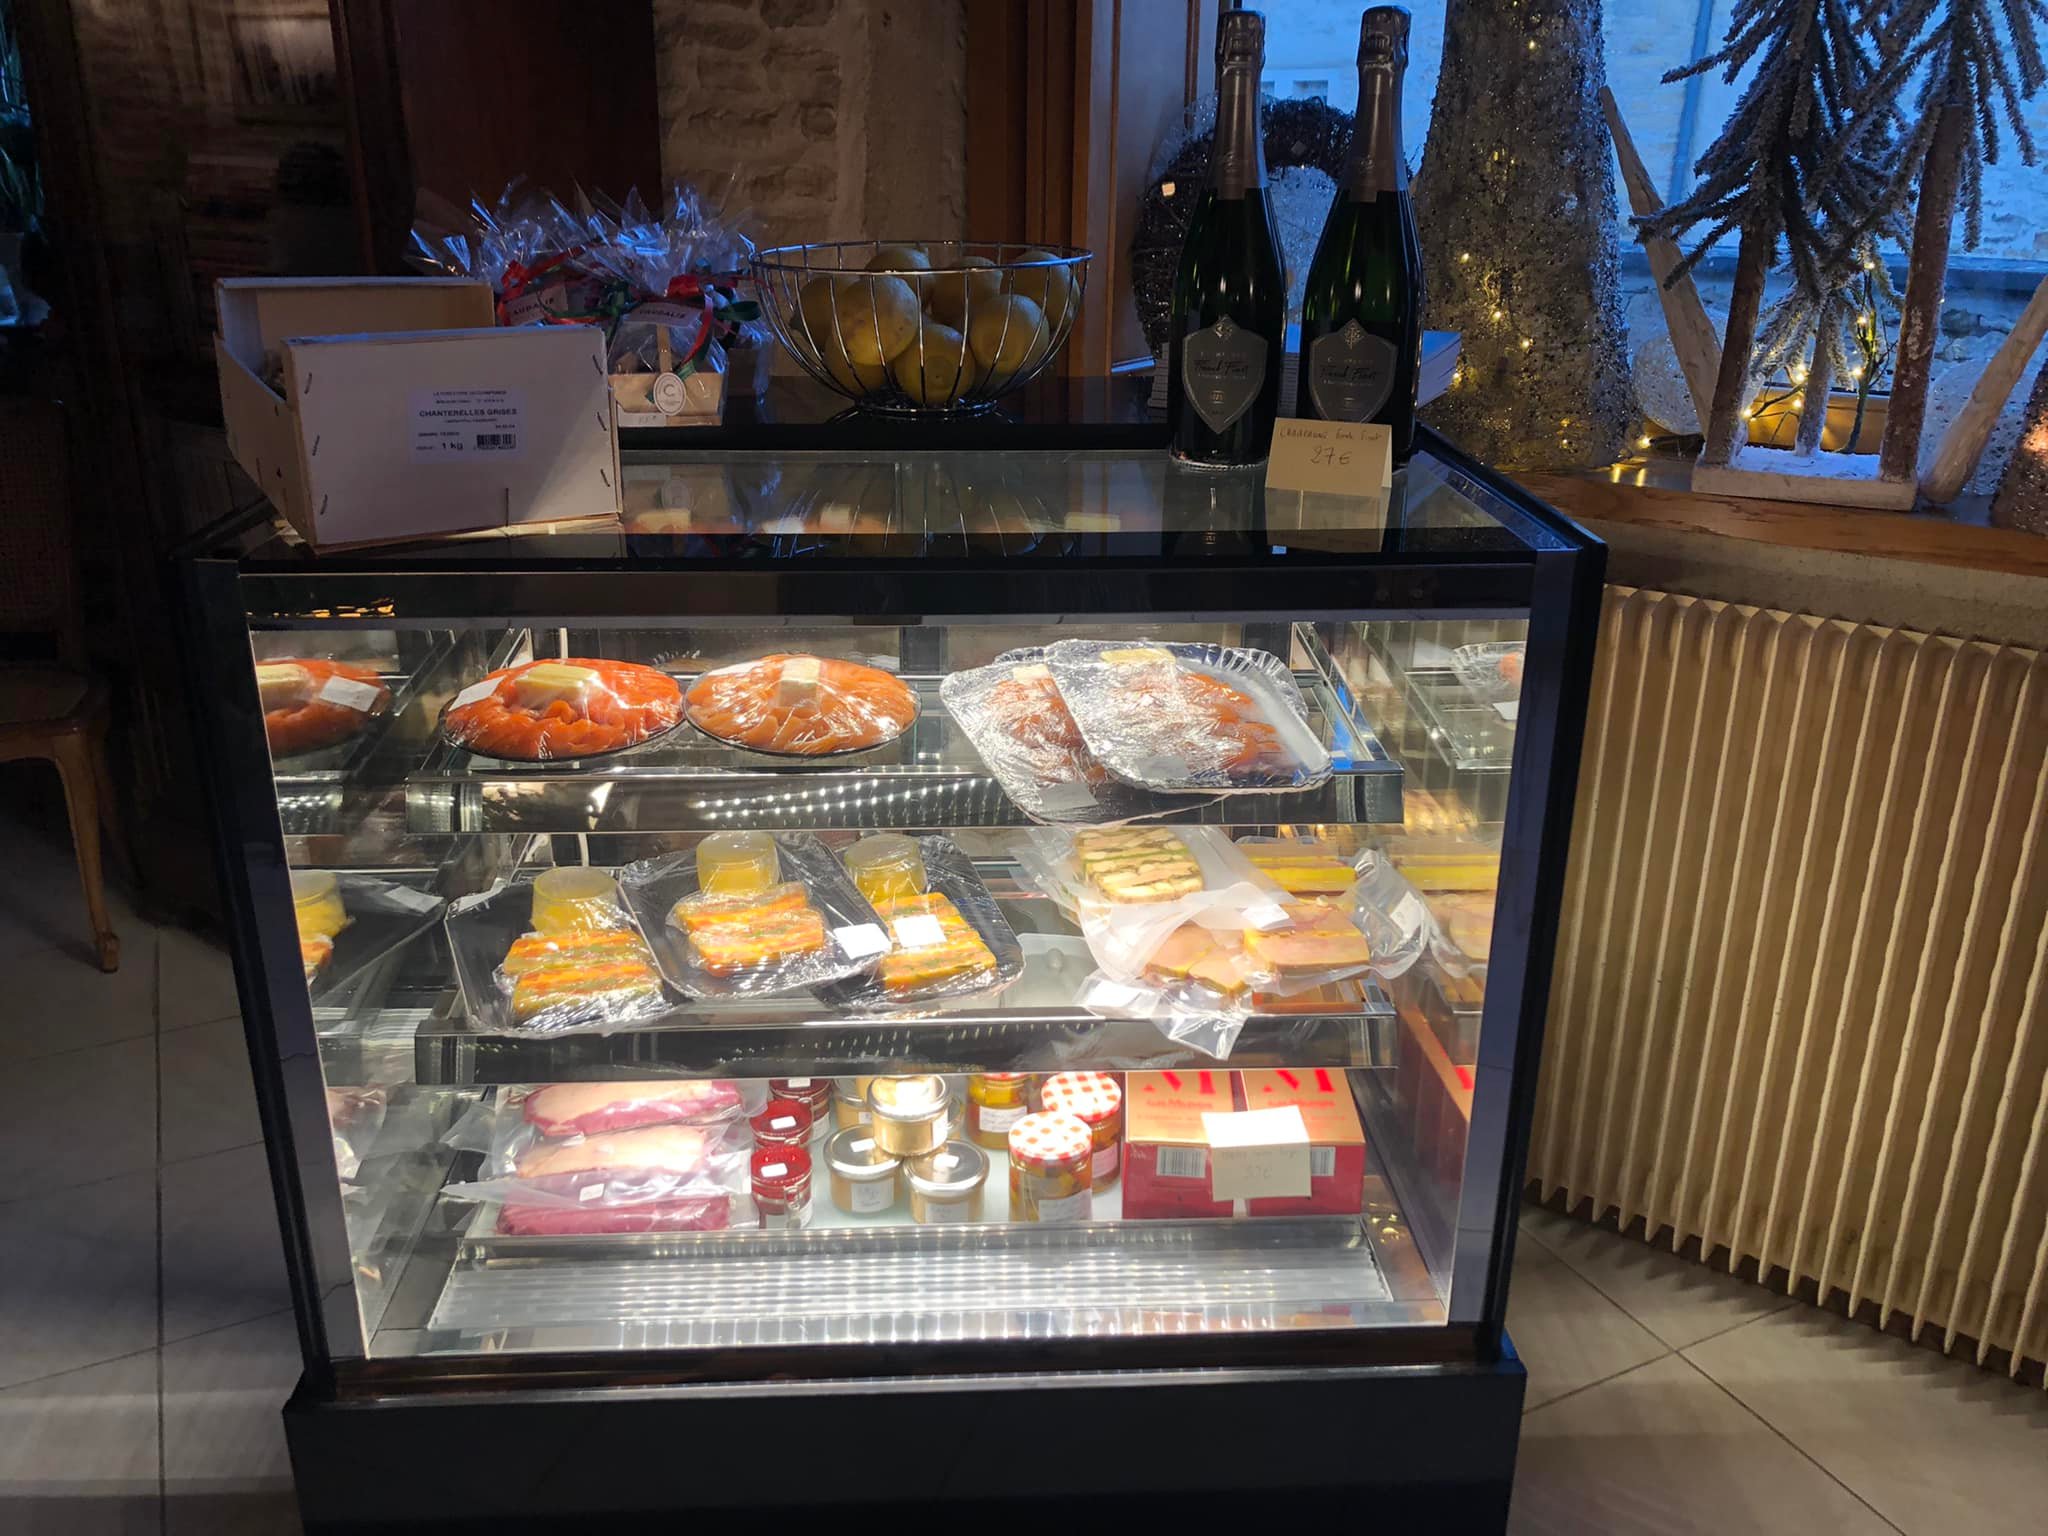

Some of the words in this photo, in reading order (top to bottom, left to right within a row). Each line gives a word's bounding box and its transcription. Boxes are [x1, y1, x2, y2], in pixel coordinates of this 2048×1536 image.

[419, 408, 486, 418] CHANTERELLES
[487, 408, 518, 416] GRISES
[450, 442, 464, 451] kg
